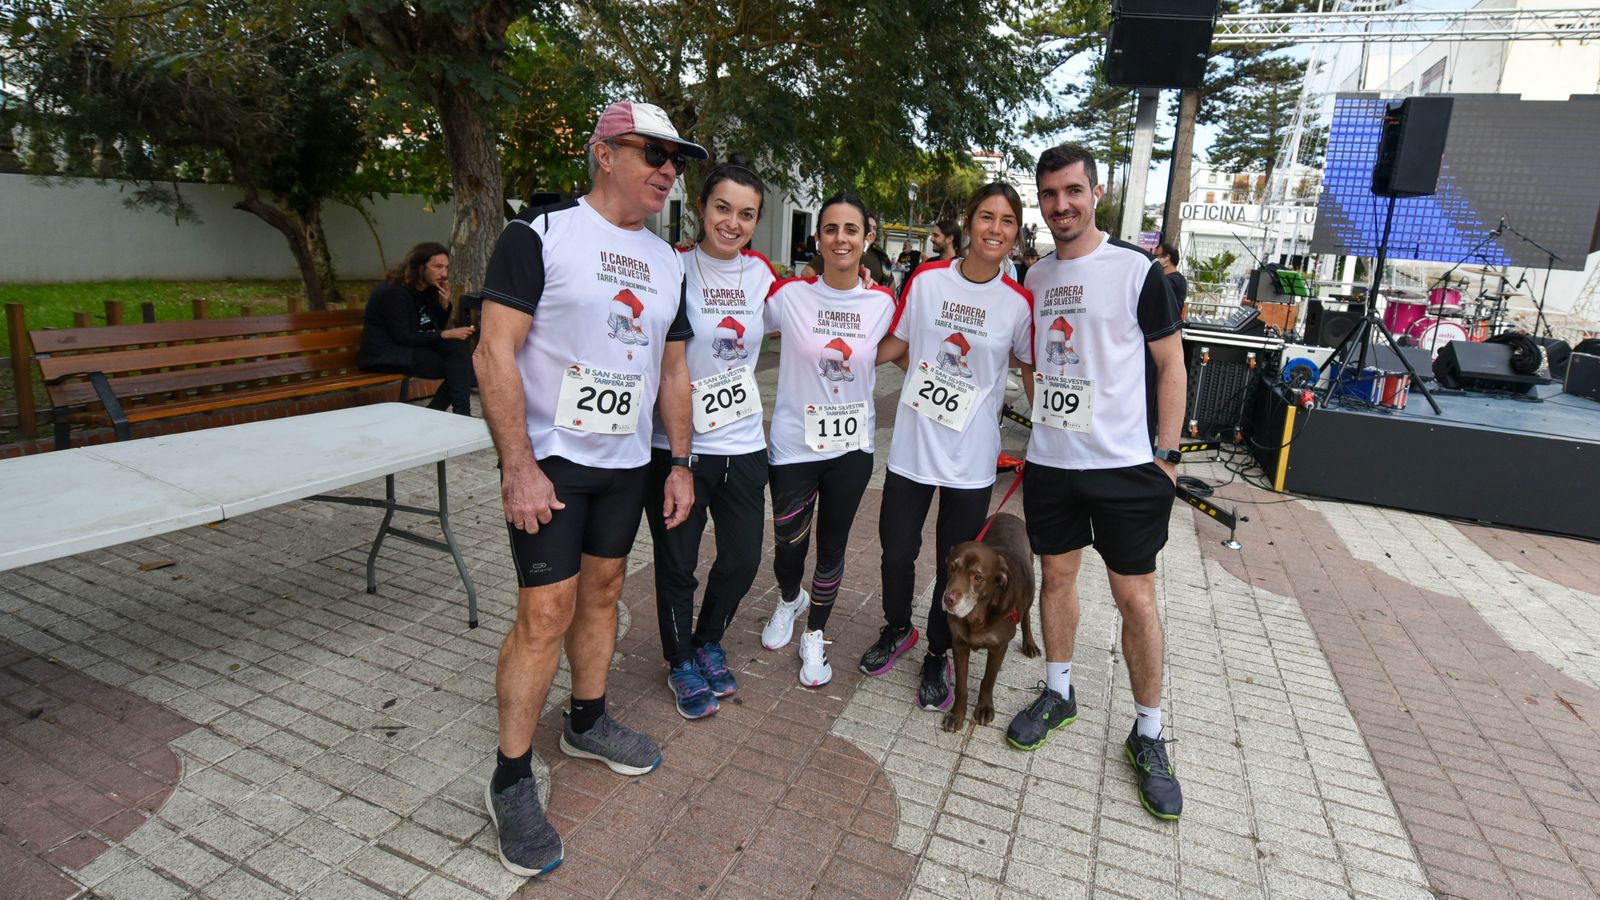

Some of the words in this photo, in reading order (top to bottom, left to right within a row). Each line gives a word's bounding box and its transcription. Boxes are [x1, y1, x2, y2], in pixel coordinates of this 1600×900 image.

[1182, 204, 1246, 222] OFICINA
[600, 251, 607, 263] II
[609, 253, 650, 274] CARRERA
[602, 262, 617, 274] SAN
[617, 266, 651, 283] SILVESTRE
[702, 288, 709, 298] II
[710, 288, 746, 299] CARRERA
[1044, 289, 1050, 300] II
[1050, 285, 1084, 299] CARRERA
[704, 298, 718, 306] SAN
[717, 298, 747, 307] SILVESTRE
[943, 300, 949, 311] II
[949, 302, 986, 320] CARRERA
[1043, 298, 1053, 308] SAN
[1053, 296, 1083, 306] SILVESTRE
[817, 318, 830, 327] SAN
[830, 320, 862, 331] SILVESTRE
[818, 309, 823, 319] II
[824, 310, 862, 323] CARRERA
[941, 311, 954, 320] SAN
[954, 313, 985, 328] SILVESTRE
[591, 369, 610, 378] SAN
[611, 372, 643, 382] SILVESTRE
[593, 377, 624, 387] TARIFEÑA
[703, 376, 718, 385] SAN
[718, 366, 747, 381] SILVESTRE
[935, 368, 948, 379] SAN
[948, 376, 976, 392] SILVESTRE
[1060, 377, 1091, 387] SILVESTRE
[576, 386, 632, 415] 208
[702, 383, 747, 415] 205
[918, 380, 960, 412] 206
[1042, 389, 1080, 414] 109
[837, 402, 865, 411] SILVESTRE
[818, 417, 857, 437] 110
